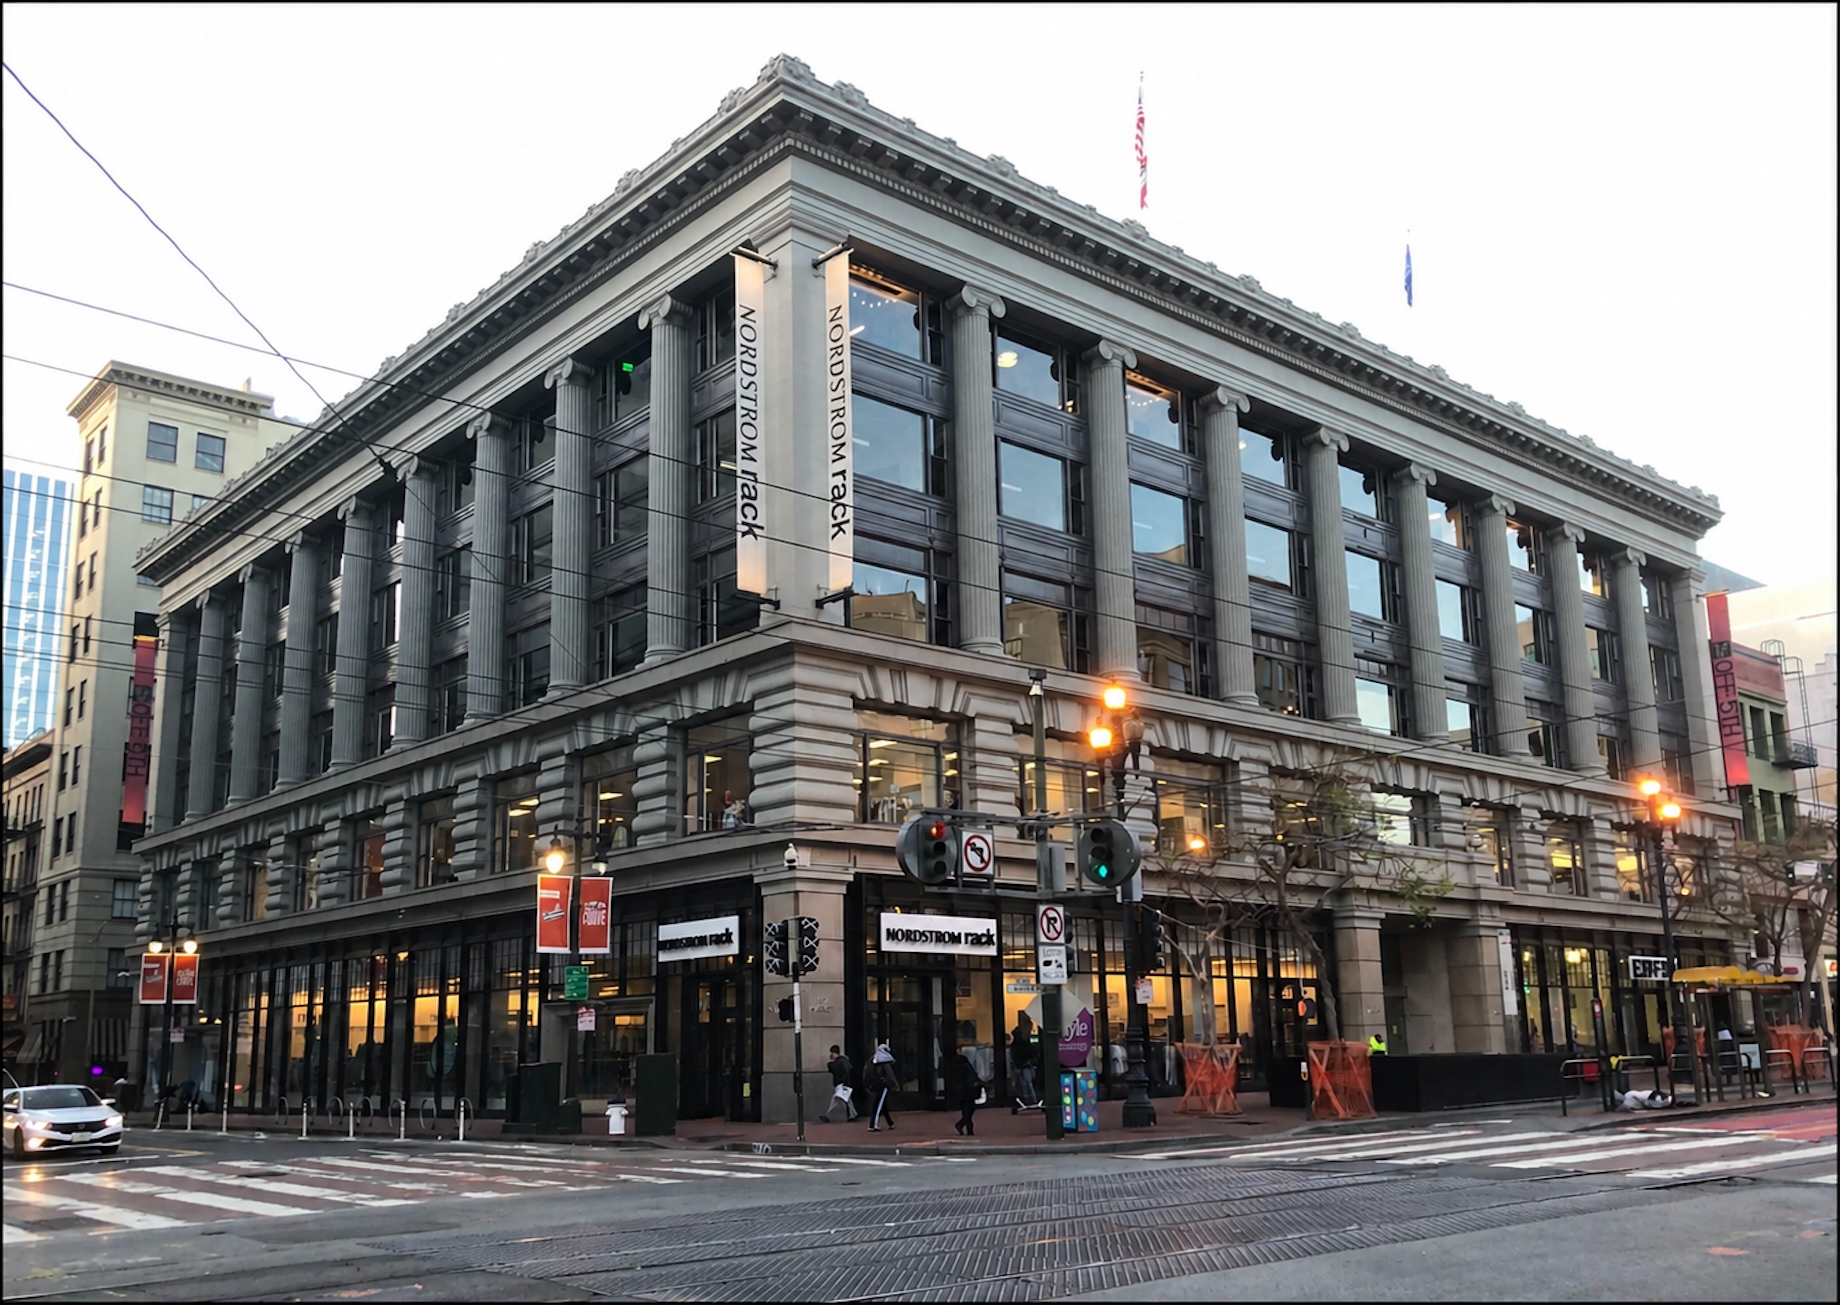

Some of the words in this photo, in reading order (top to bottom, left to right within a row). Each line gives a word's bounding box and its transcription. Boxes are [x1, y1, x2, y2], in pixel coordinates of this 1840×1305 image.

[739, 304, 757, 463] NORDSTROM
[829, 304, 847, 463] NORDSTROM
[741, 469, 764, 541] rack
[831, 468, 851, 540] rack
[1720, 700, 1741, 737] 5TH
[658, 934, 708, 951] OSTOM
[886, 927, 962, 945] NORDSTROM
[965, 928, 995, 946] rack
